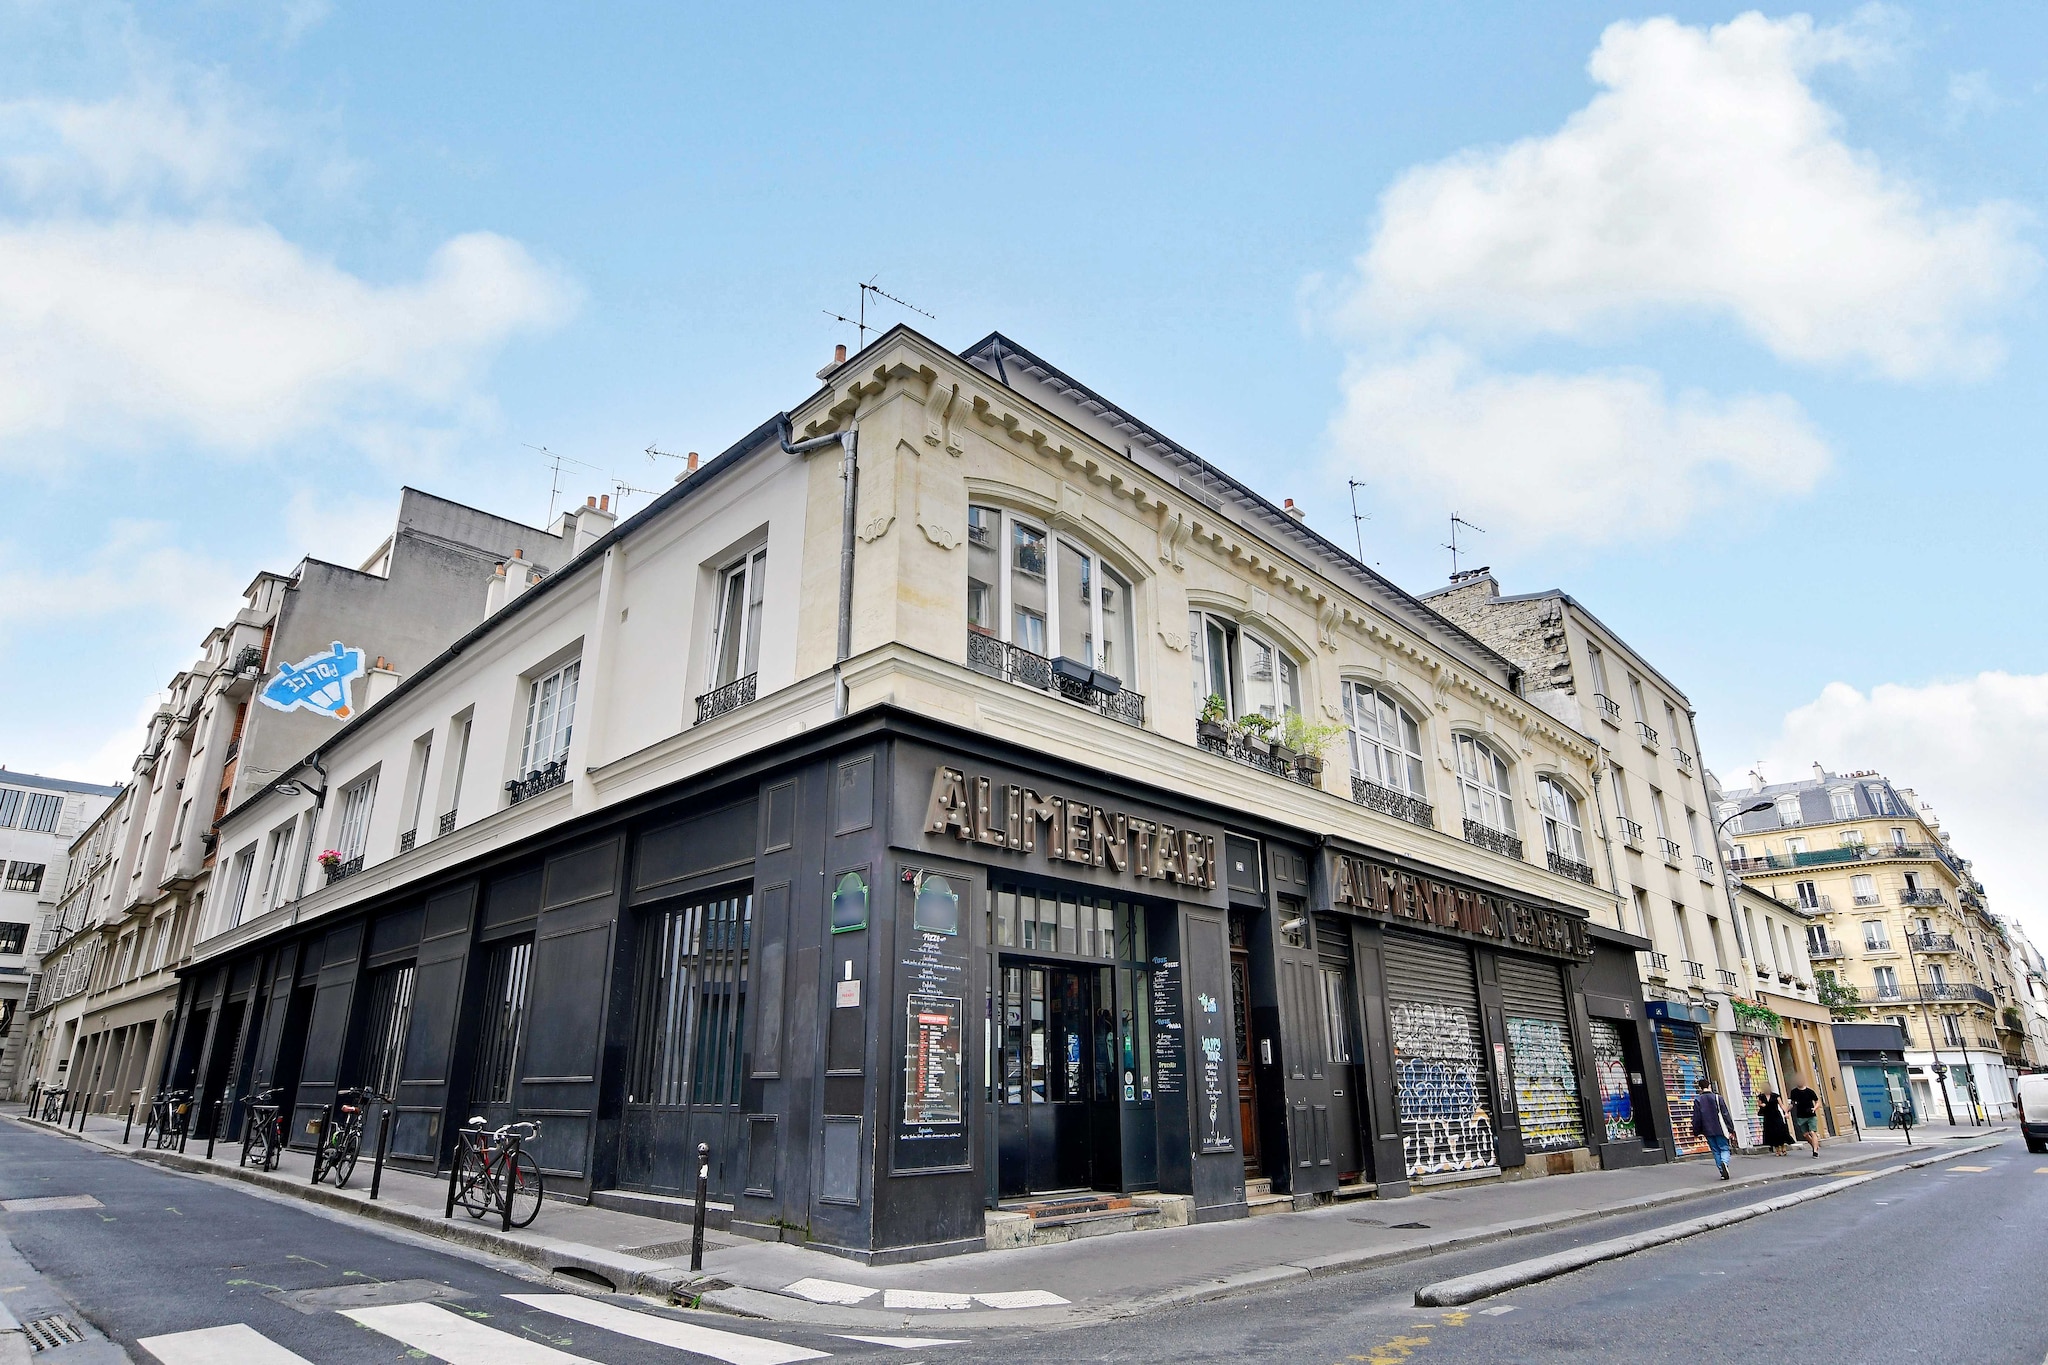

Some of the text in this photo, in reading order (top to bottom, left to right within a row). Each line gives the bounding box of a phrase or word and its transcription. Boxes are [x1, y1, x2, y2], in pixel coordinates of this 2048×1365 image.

[282, 663, 339, 693] POLICE
[924, 765, 1217, 890] ALIMENTARI
[1333, 854, 1506, 940] ALIMENTATION
